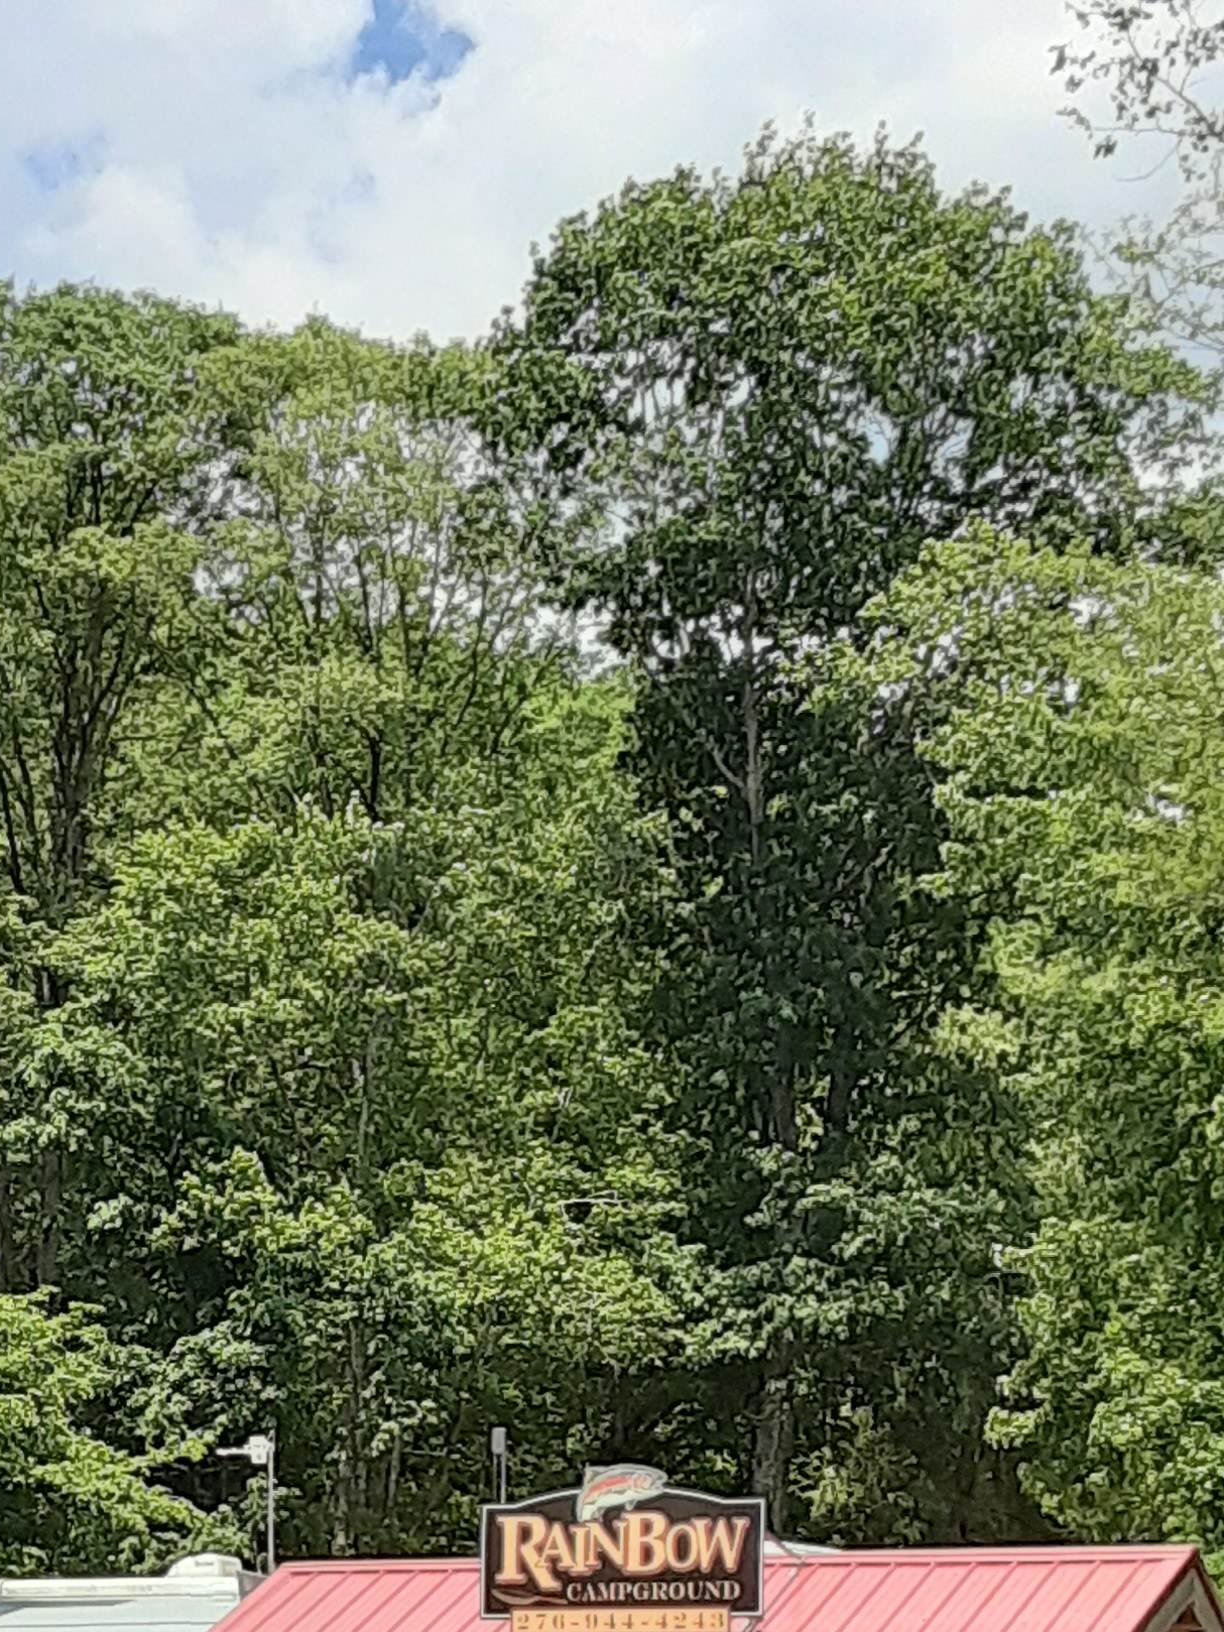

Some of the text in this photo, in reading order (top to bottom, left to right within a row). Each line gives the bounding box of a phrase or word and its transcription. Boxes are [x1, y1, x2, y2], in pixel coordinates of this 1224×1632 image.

[494, 1510, 751, 1593] RAINBOW
[566, 1580, 742, 1601] CAMPGROUND
[516, 1612, 725, 1631] 276-944-4243
